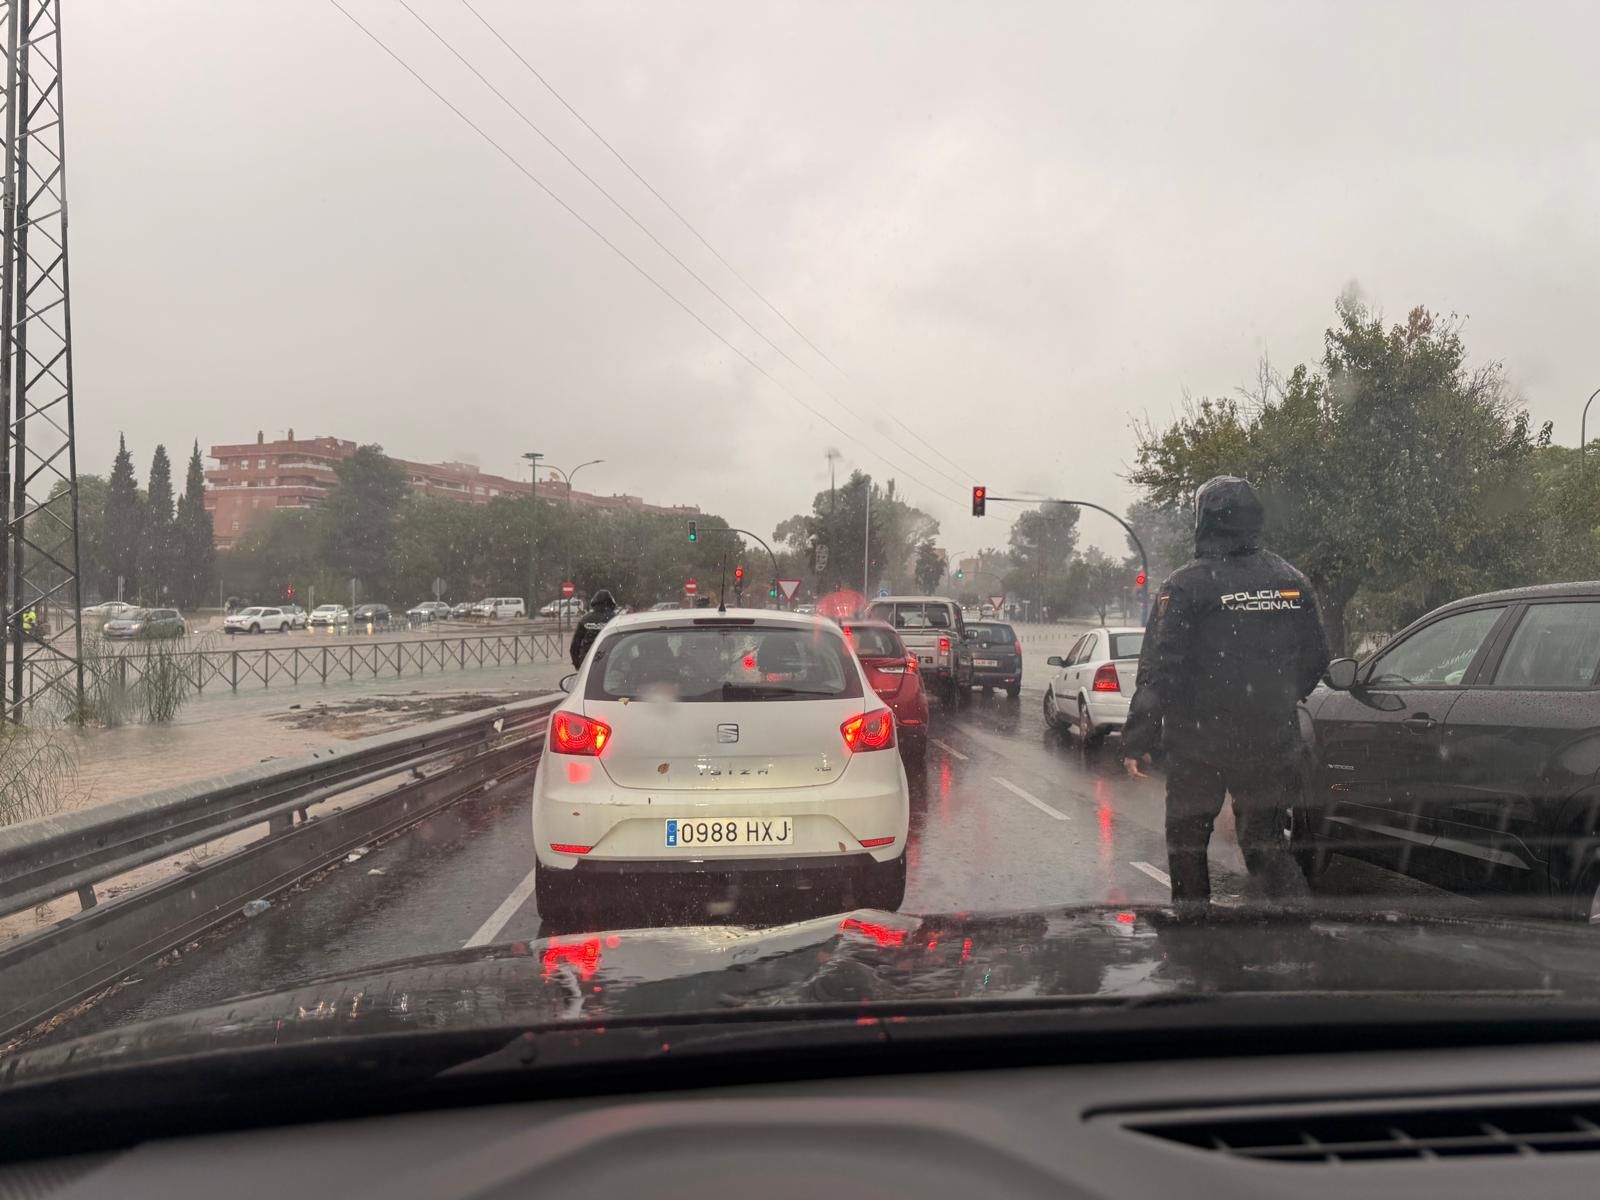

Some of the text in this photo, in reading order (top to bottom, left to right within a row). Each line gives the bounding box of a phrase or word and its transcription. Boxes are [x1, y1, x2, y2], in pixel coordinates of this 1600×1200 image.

[1220, 589, 1282, 604] POLICIA
[1220, 600, 1301, 611] NACIONAL
[681, 822, 738, 843] 0988
[747, 821, 788, 842] HXJ
